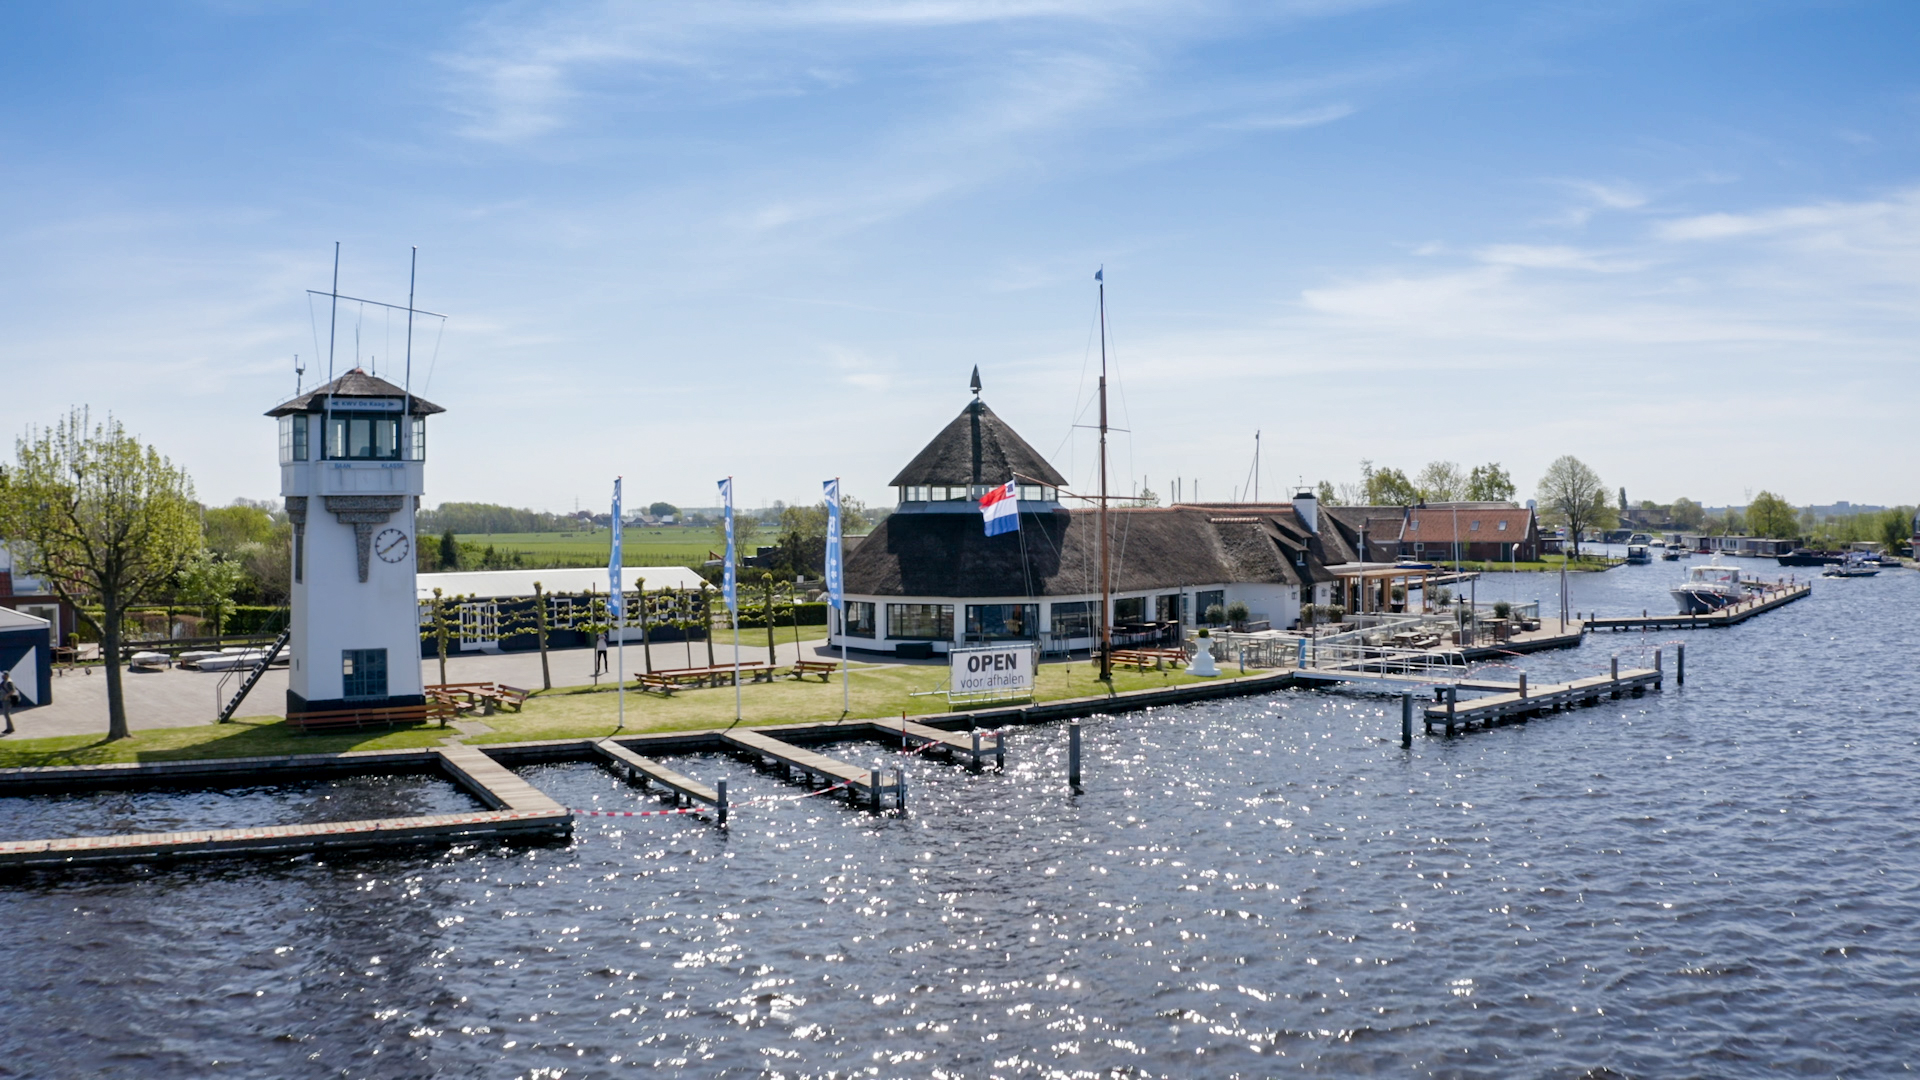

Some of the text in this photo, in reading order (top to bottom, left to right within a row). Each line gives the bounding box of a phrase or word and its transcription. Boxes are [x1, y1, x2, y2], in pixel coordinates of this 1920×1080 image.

[967, 653, 1017, 673] OPEN
[961, 674, 1024, 688] voor afhalen
